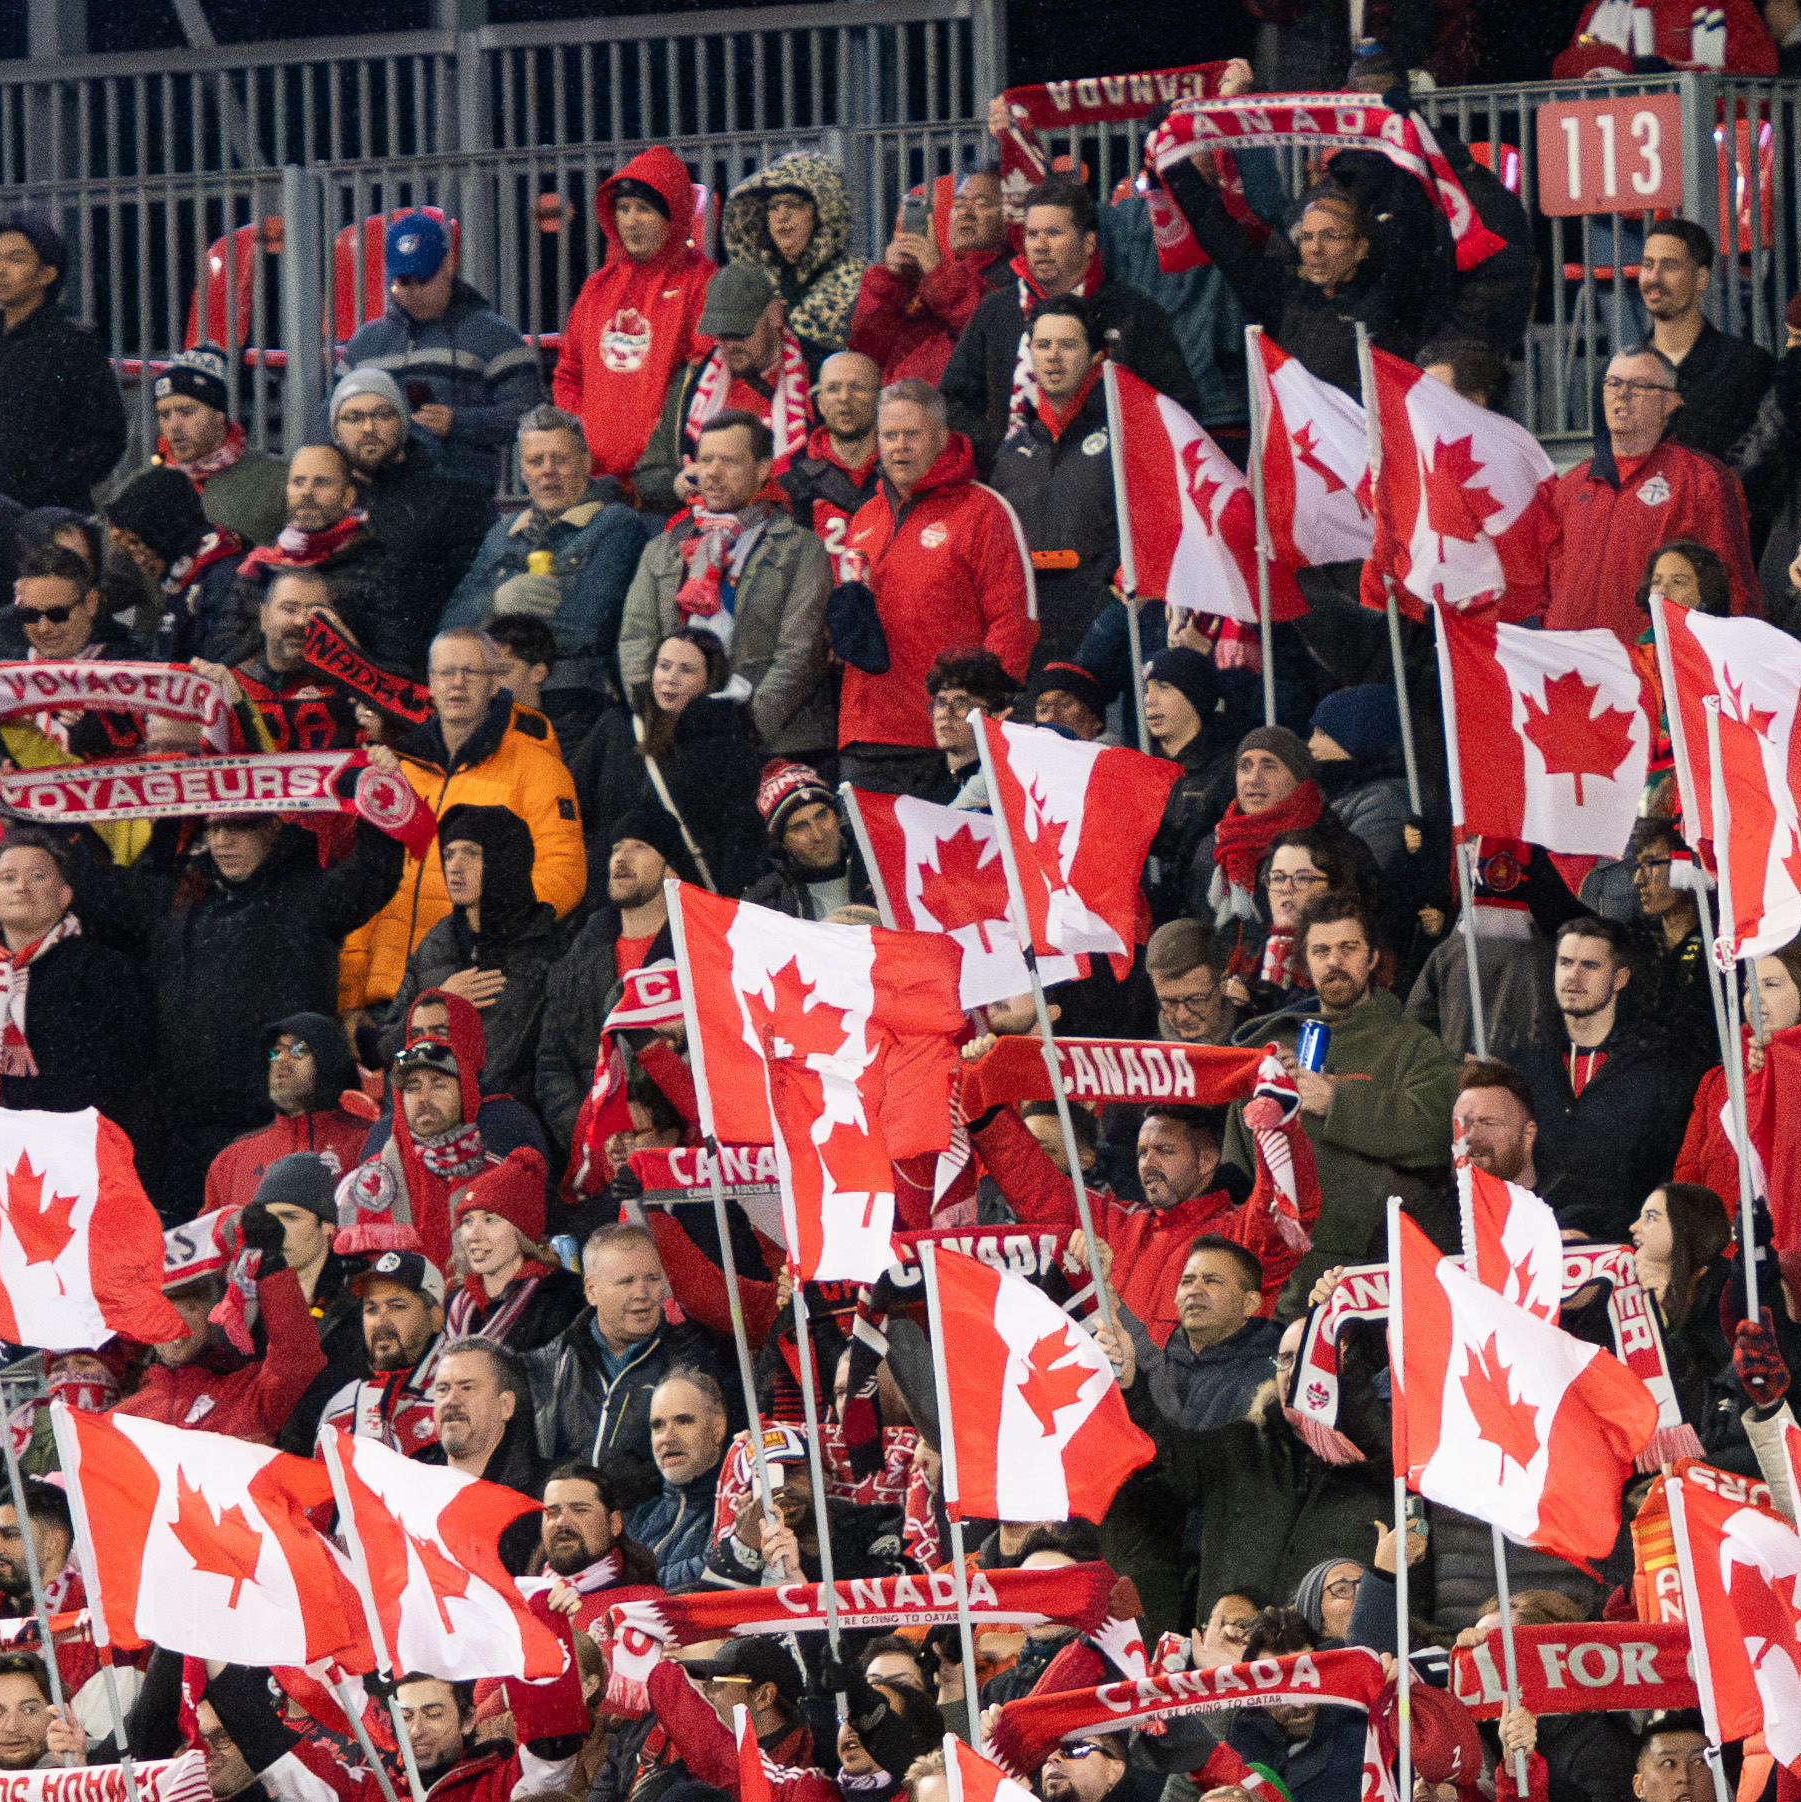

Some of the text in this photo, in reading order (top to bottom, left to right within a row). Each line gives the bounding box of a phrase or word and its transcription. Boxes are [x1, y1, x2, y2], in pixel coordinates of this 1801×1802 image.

[1558, 110, 1661, 200] 113
[0, 764, 321, 819] VOYAGEURS
[1056, 1045, 1193, 1098] CANADA
[667, 1146, 778, 1188] CANA
[887, 1235, 1058, 1288] CNADA
[776, 1572, 999, 1613] CANADA
[1095, 1652, 1322, 1709] CANADA
[1535, 1640, 1662, 1688] FOR
